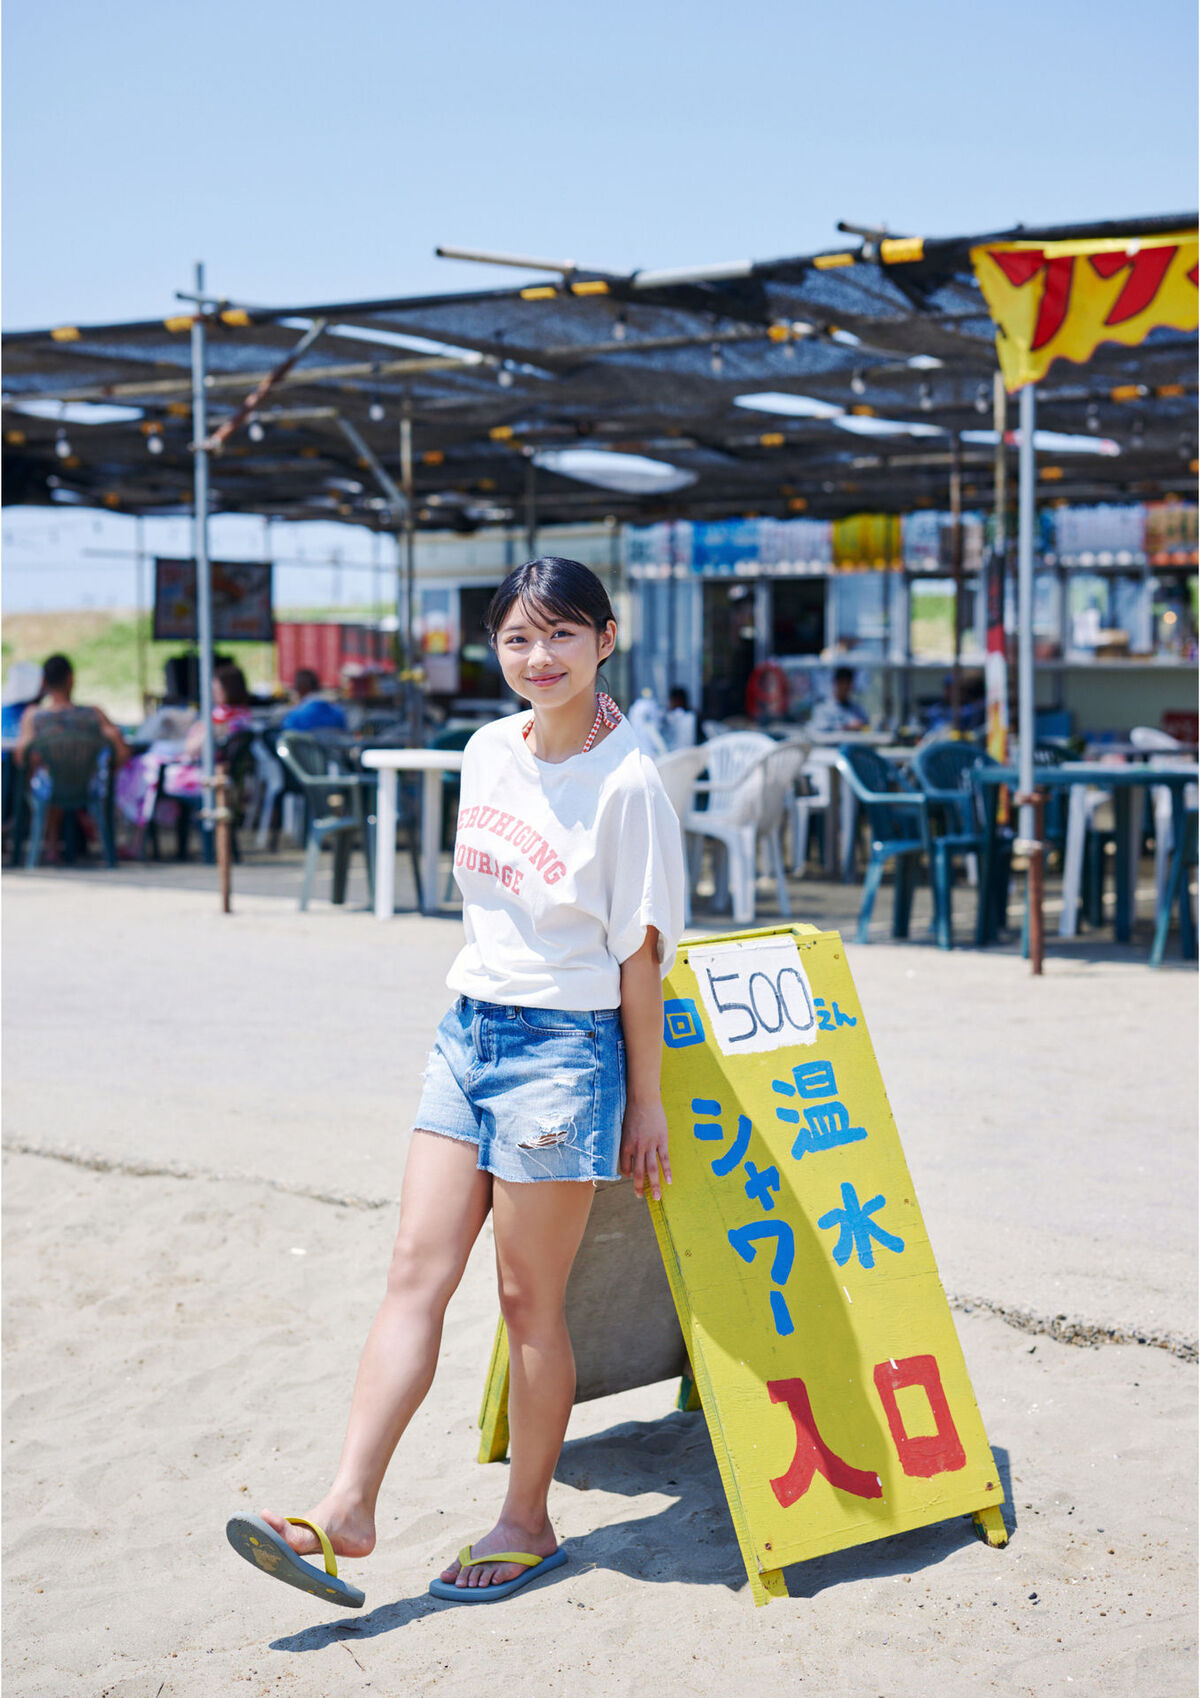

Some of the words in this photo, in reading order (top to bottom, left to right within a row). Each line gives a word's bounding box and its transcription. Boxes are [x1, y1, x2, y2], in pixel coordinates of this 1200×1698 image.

[456, 843, 525, 896] OURGE
[706, 967, 815, 1043] 500
[691, 1098, 795, 1336] シャワー
[771, 1059, 905, 1269] 温水
